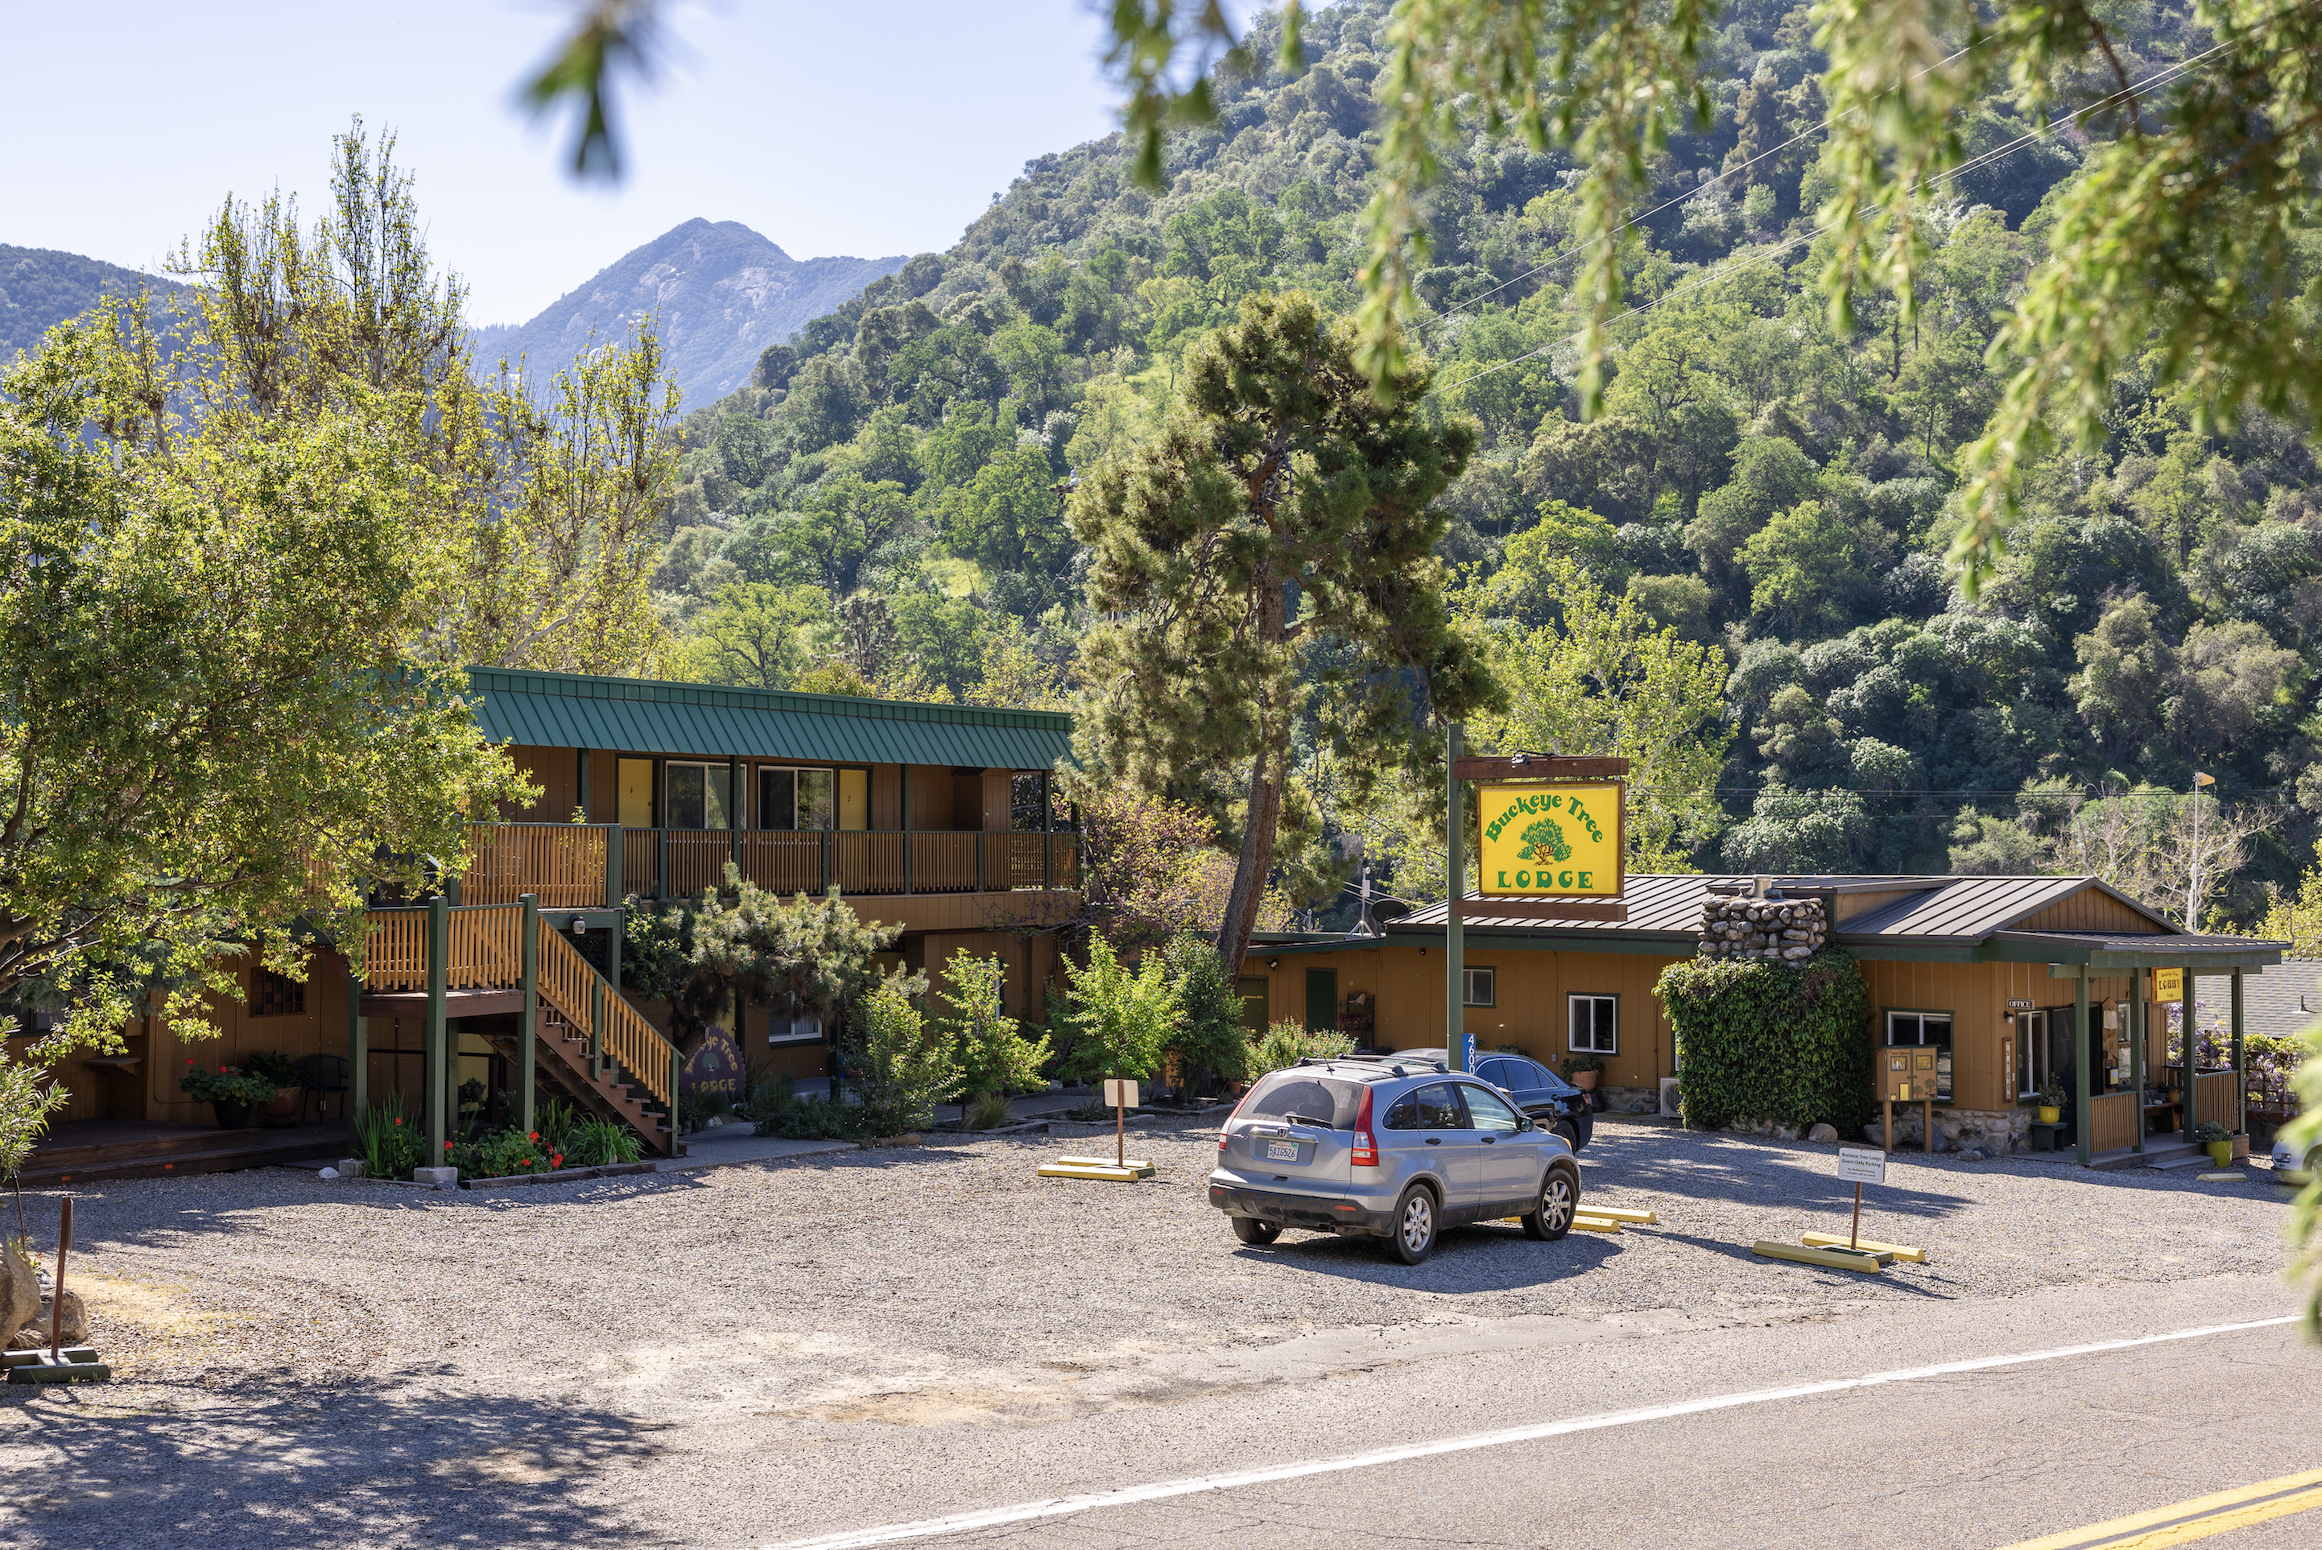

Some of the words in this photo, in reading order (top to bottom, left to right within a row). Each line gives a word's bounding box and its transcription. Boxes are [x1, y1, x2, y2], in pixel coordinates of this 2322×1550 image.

[1485, 794, 1562, 843] Buckeye
[1568, 796, 1603, 843] Tree
[1497, 870, 1593, 889] LODGE
[2159, 979, 2181, 990] LOBBY
[2009, 1000, 2031, 1008] OFFICE
[721, 1038, 738, 1071] Tree
